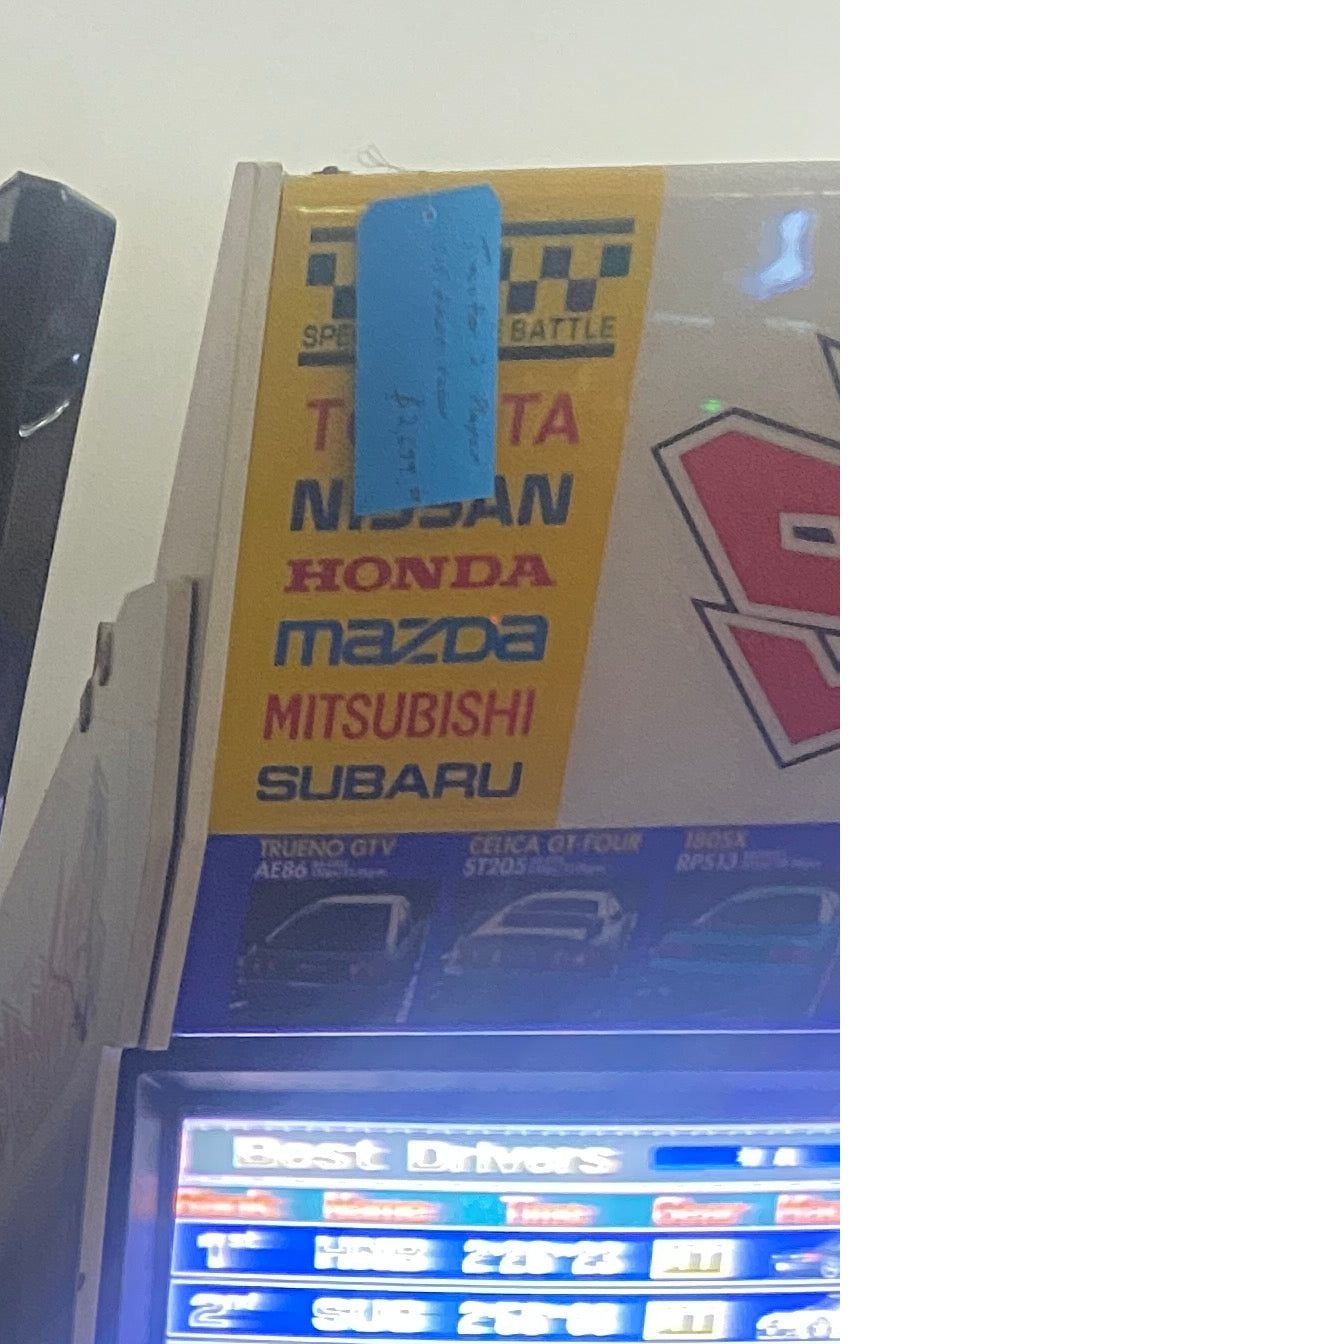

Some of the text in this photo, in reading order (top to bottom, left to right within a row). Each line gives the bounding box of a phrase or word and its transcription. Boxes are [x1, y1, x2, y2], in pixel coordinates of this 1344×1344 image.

[511, 315, 617, 343] BATTLE
[306, 391, 580, 451] TTA
[283, 553, 556, 593] HONDA
[274, 614, 549, 666] mazda
[263, 688, 537, 741] MITSUBISHI
[256, 760, 523, 802] SUBARU
[254, 858, 309, 880] AE86
[407, 1139, 618, 1174] Drivers
